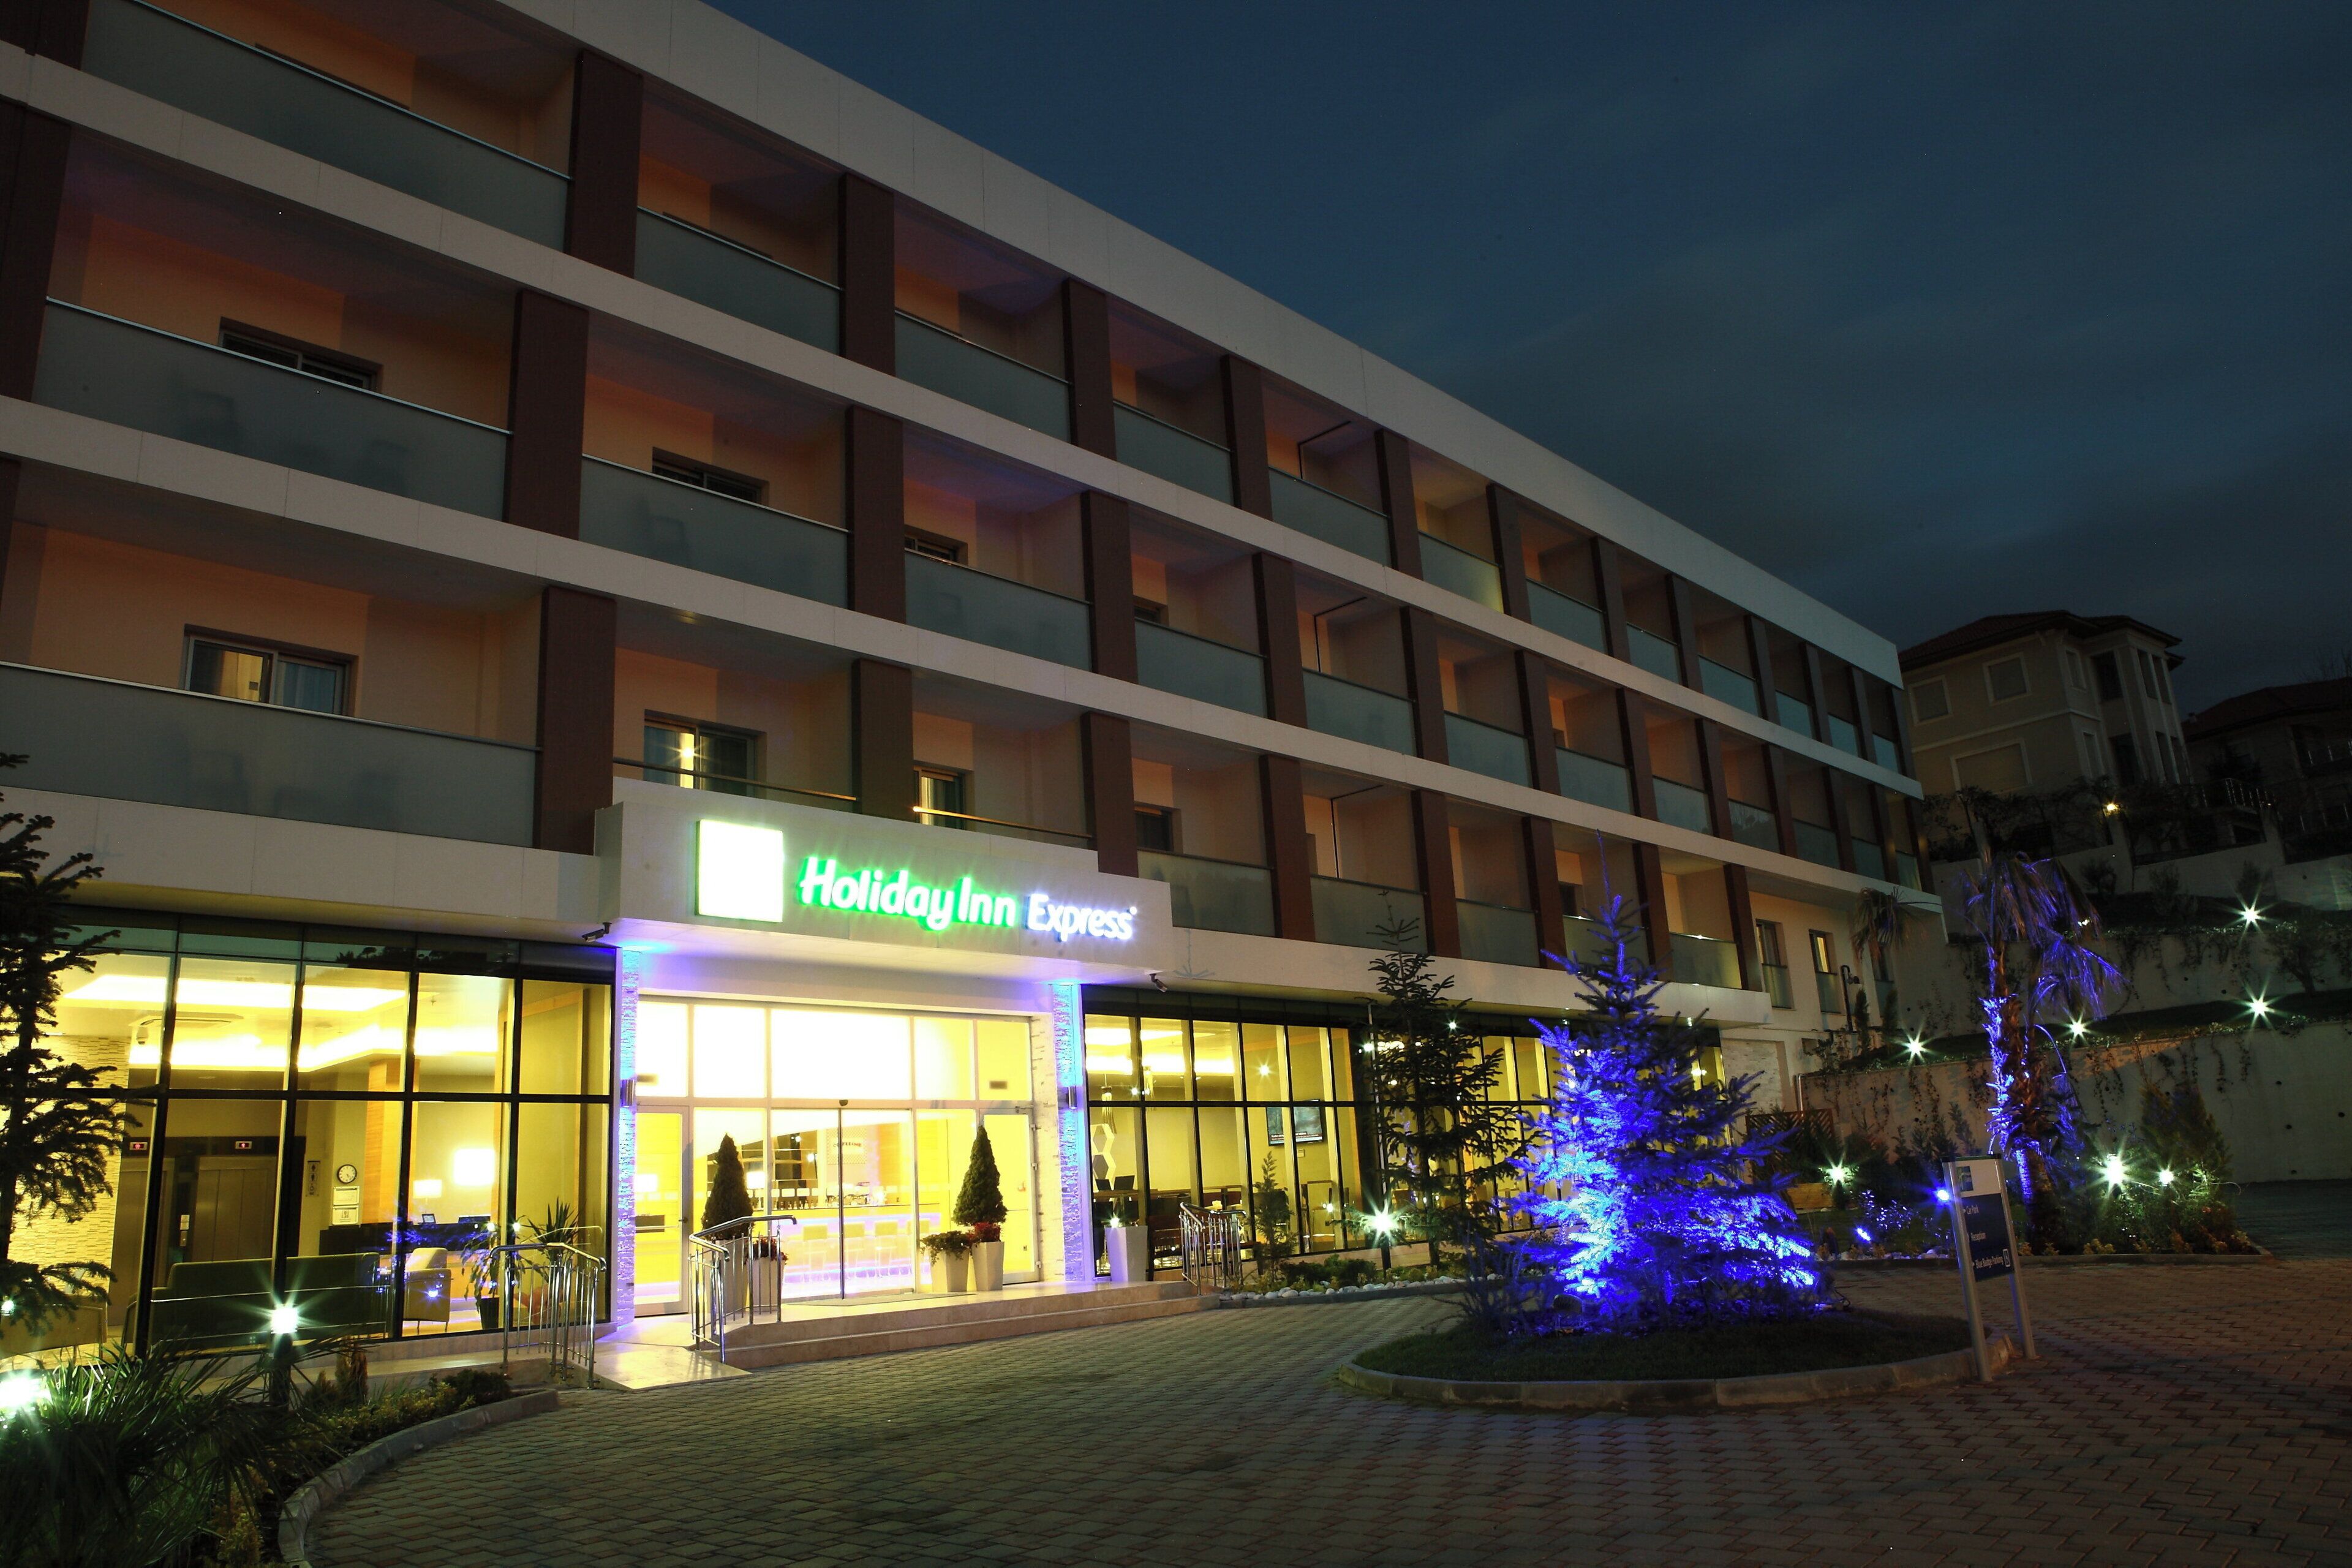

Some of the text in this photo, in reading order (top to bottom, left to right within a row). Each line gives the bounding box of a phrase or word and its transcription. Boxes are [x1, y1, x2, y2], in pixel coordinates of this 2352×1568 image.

[798, 856, 1133, 942] Holiday Inn Express
